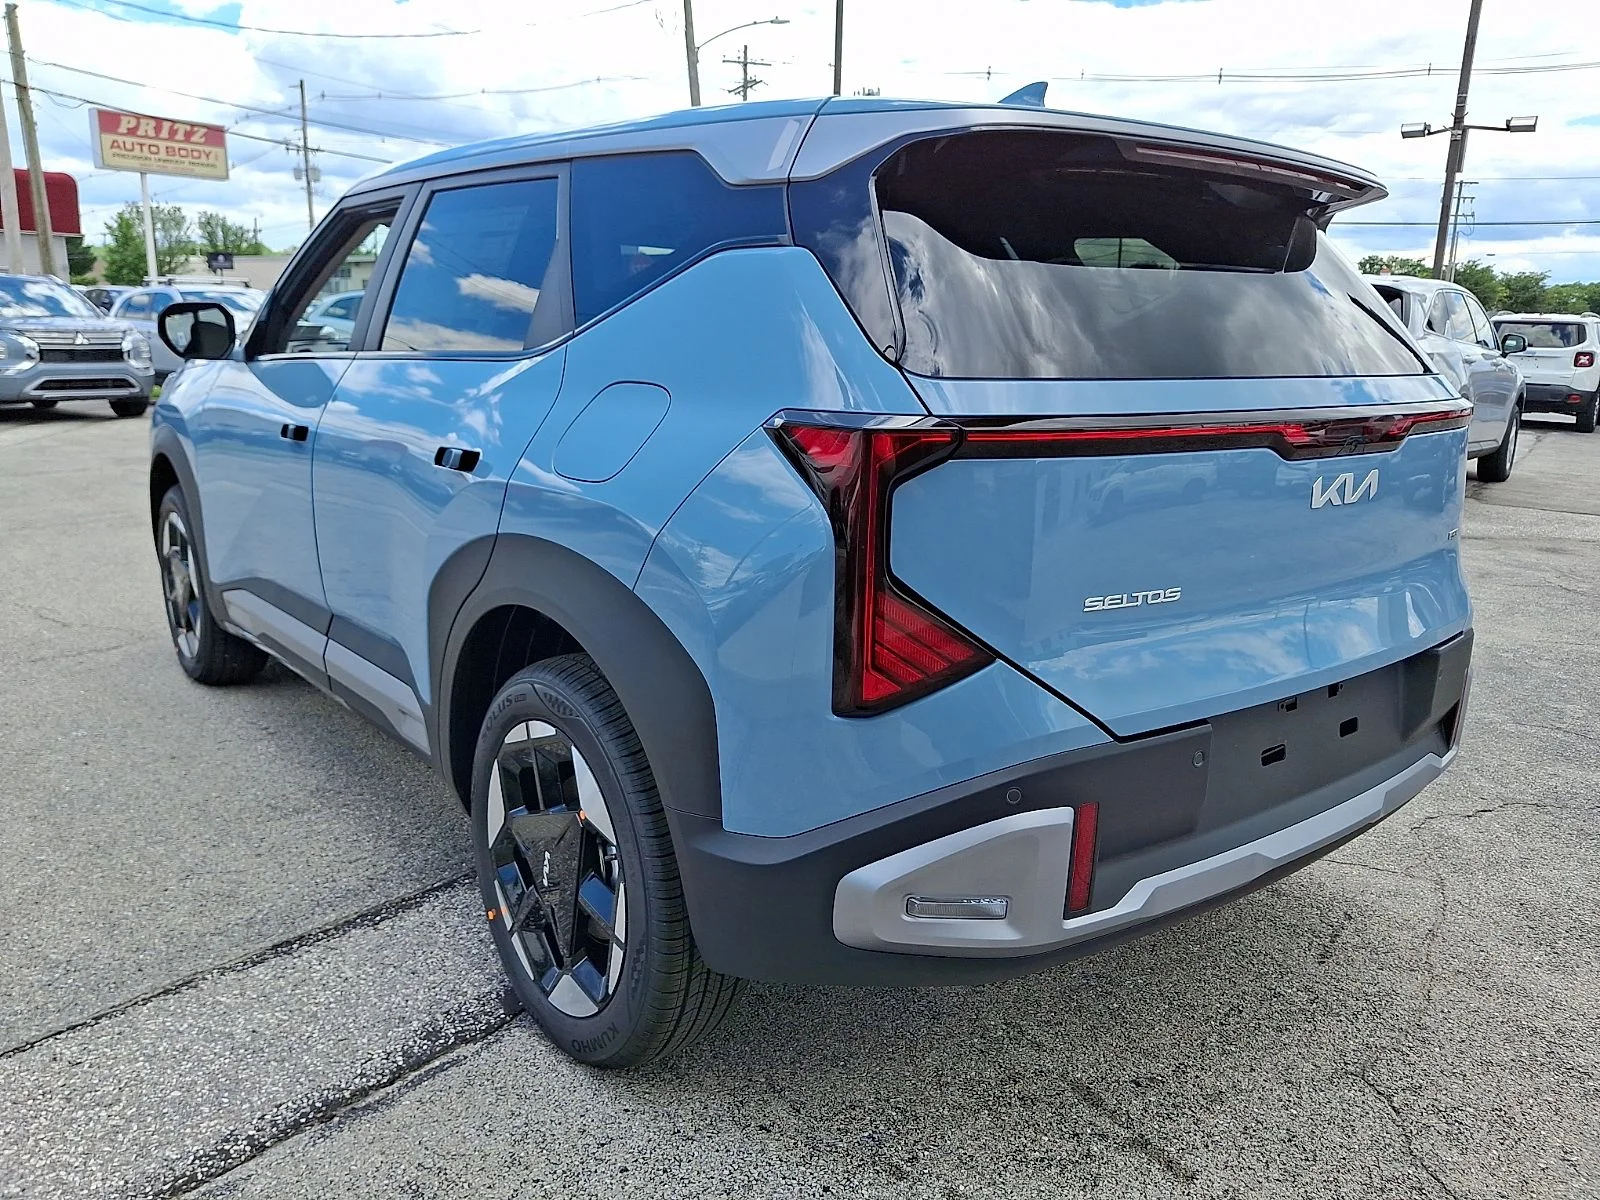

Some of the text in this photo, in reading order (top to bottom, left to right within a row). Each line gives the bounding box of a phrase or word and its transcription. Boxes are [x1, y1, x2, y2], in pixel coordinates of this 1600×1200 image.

[117, 115, 208, 144] PRITZ
[110, 139, 160, 155] AUTO
[165, 145, 213, 161] BODY
[1311, 468, 1379, 510] KIA
[1083, 586, 1182, 613] SELTOS
[571, 1022, 620, 1053] KUMHO
